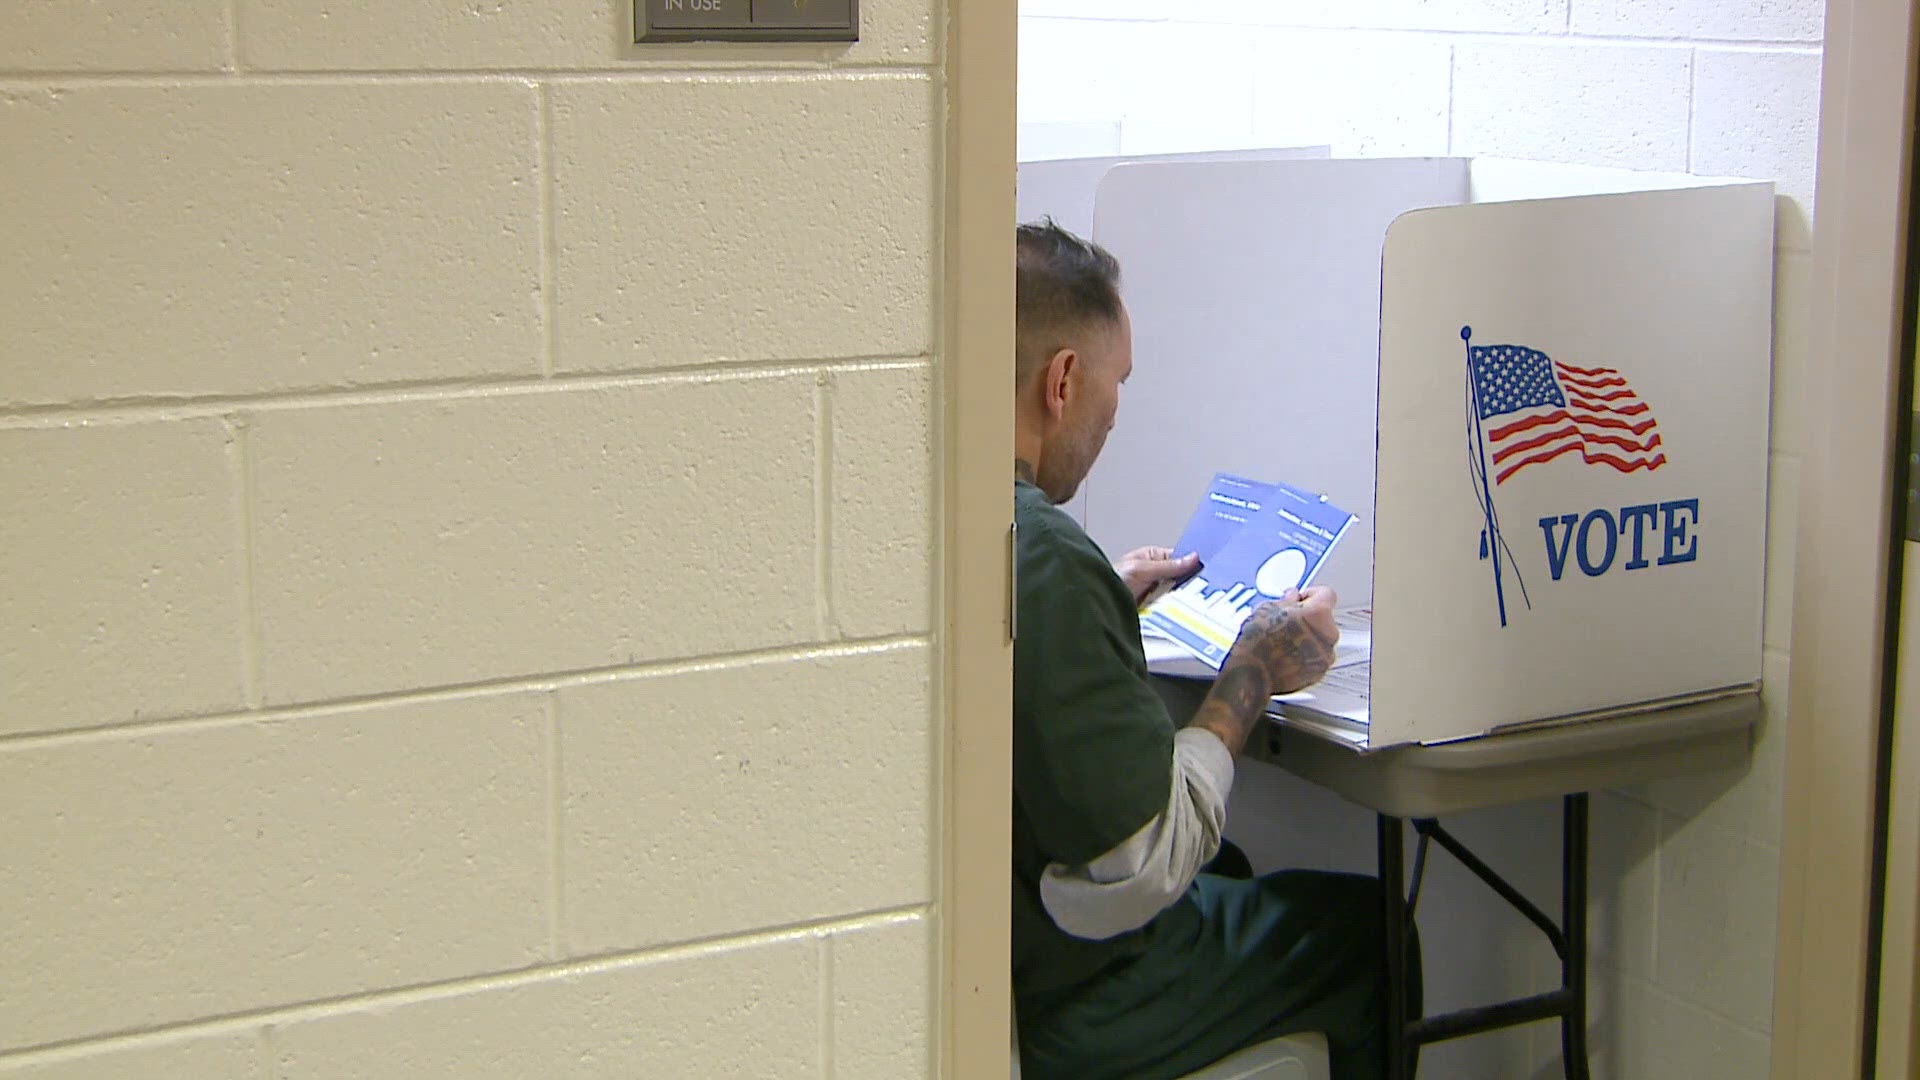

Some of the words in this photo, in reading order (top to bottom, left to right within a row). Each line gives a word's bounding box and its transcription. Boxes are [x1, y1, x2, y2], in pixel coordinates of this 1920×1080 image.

[665, 0, 683, 11] IN
[690, 0, 721, 11] USE
[1539, 498, 1699, 581] VOTE
